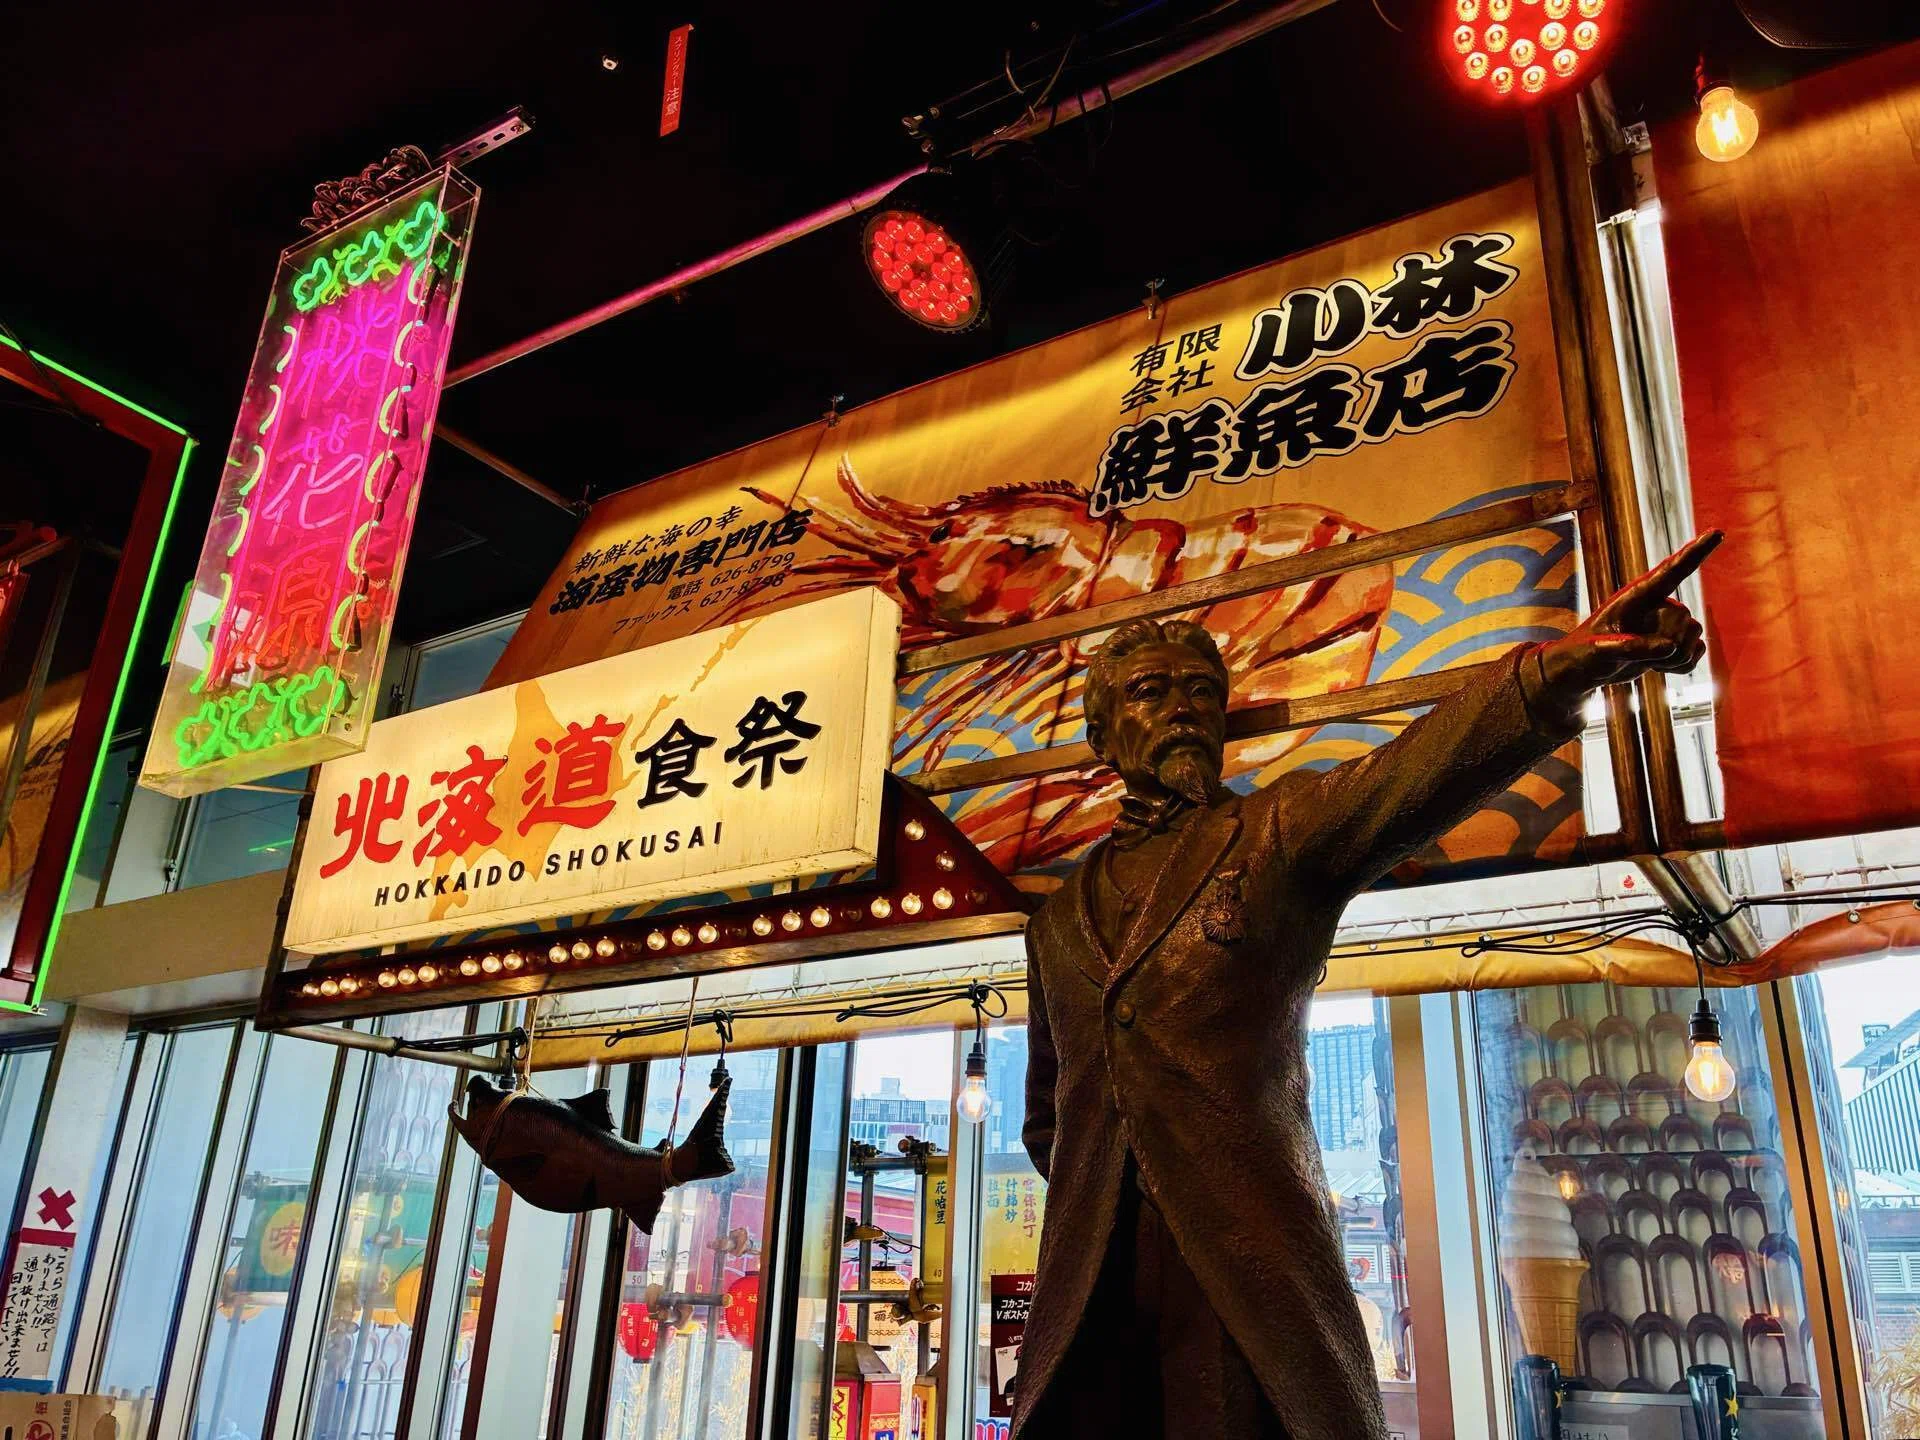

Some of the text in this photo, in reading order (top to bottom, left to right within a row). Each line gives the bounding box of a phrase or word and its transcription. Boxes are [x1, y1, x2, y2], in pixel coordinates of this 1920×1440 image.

[1234, 233, 1519, 382] 小林
[1132, 324, 1222, 378] 有限
[1087, 319, 1518, 518] 鮮魚店
[1119, 360, 1216, 415] 会社
[549, 508, 814, 615] 海産物専門店
[569, 505, 743, 575] 新鮮な海の幸
[666, 551, 796, 600] 電話 626-8799
[612, 600, 693, 634] ファックス
[373, 821, 725, 908] HOKKAIDO SHOKUSAI
[36, 1246, 68, 1353] こちら通路では
[1016, 1280, 1036, 1292] コカ
